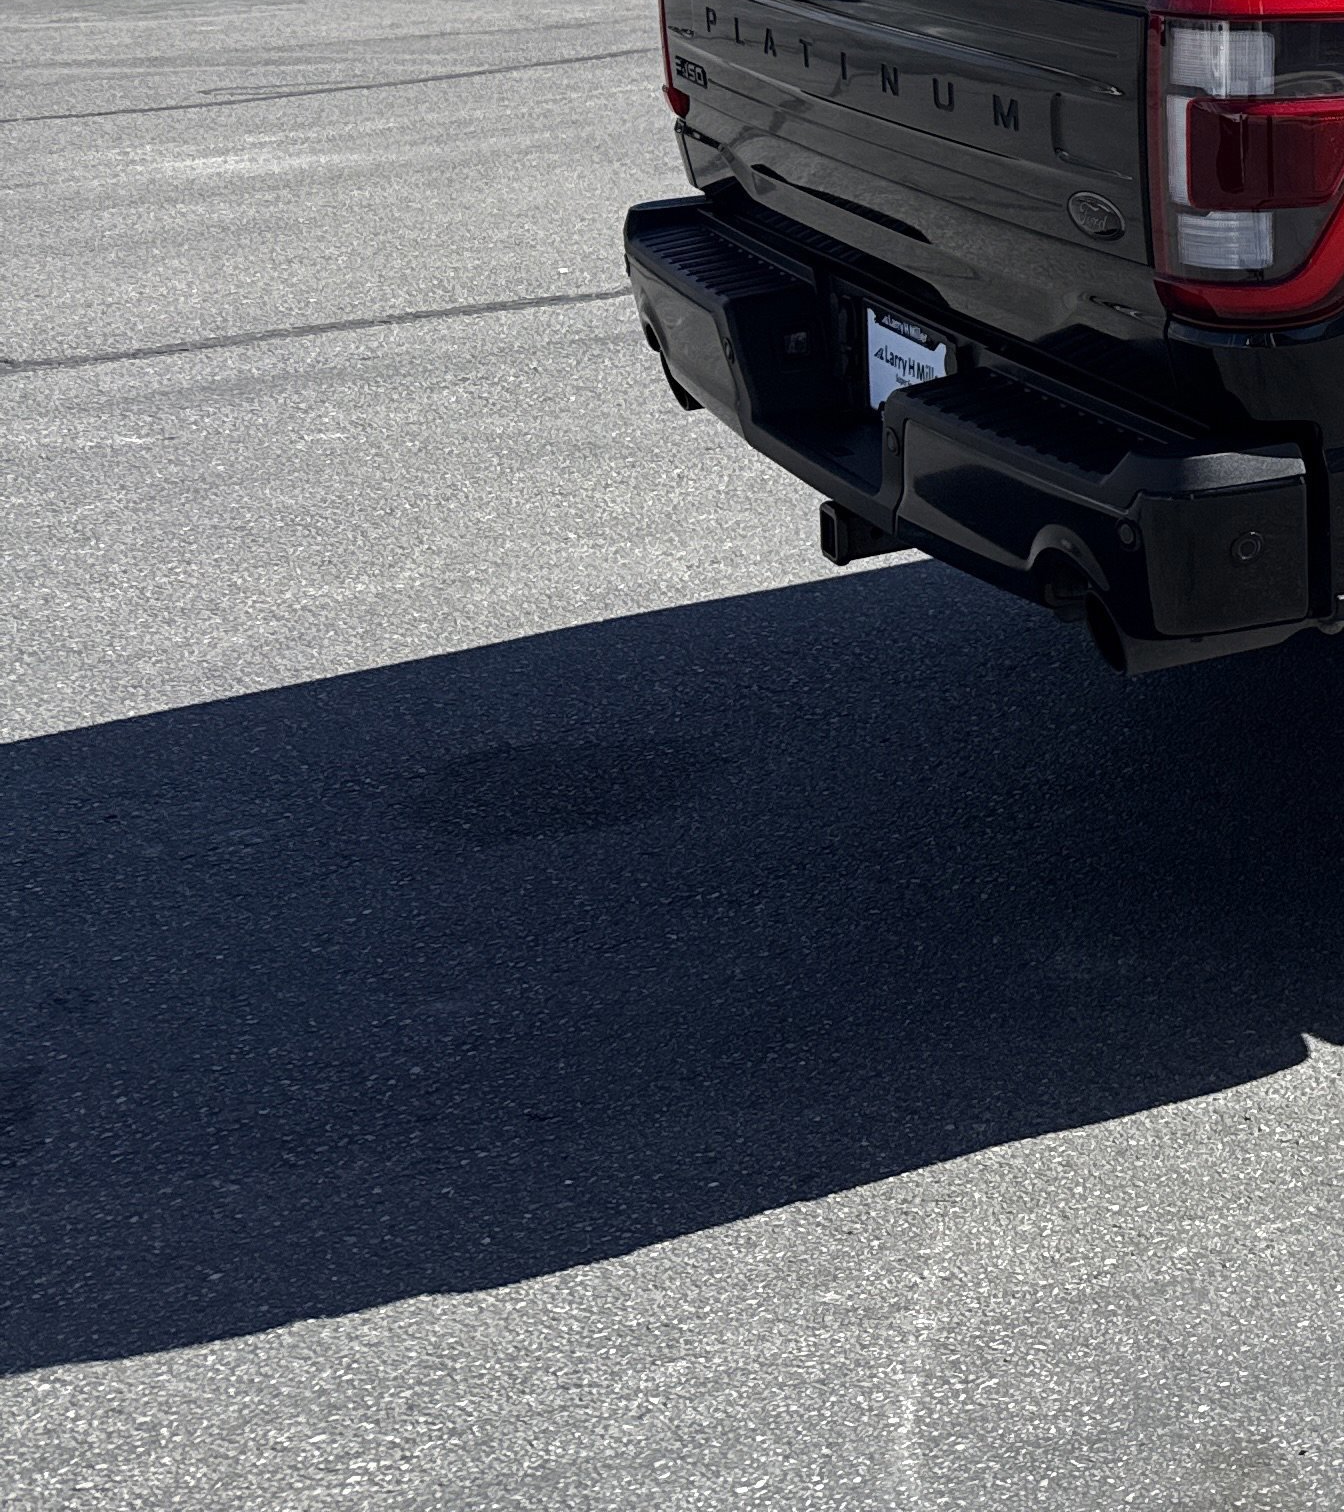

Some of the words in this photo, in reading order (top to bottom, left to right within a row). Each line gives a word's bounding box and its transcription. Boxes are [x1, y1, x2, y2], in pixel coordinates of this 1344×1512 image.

[704, 5, 1021, 133] PLATINUM
[885, 345, 907, 377] Larry
[908, 357, 916, 378] H
[916, 361, 939, 382] Mill
